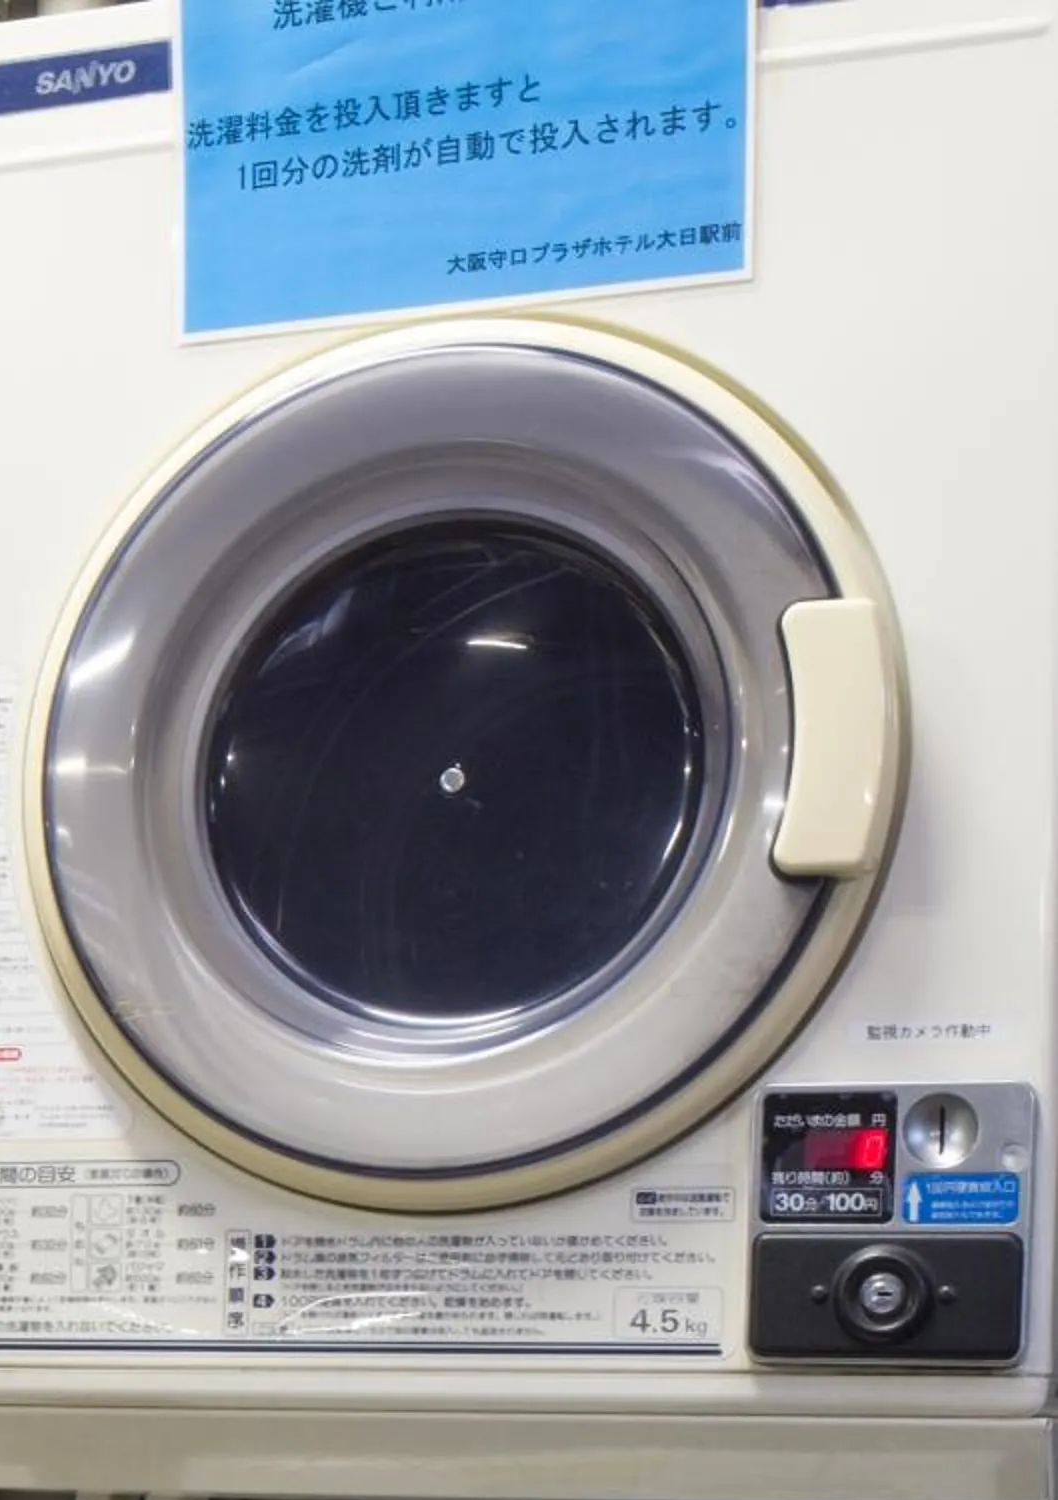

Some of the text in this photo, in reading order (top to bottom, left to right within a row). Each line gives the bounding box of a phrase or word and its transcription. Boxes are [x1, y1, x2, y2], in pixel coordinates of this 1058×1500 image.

[34, 60, 137, 96] SANYO
[186, 73, 543, 150] 洗濯料金を投入頂きますと
[236, 98, 739, 193] 1回分の洗剤が自動で投入されます。
